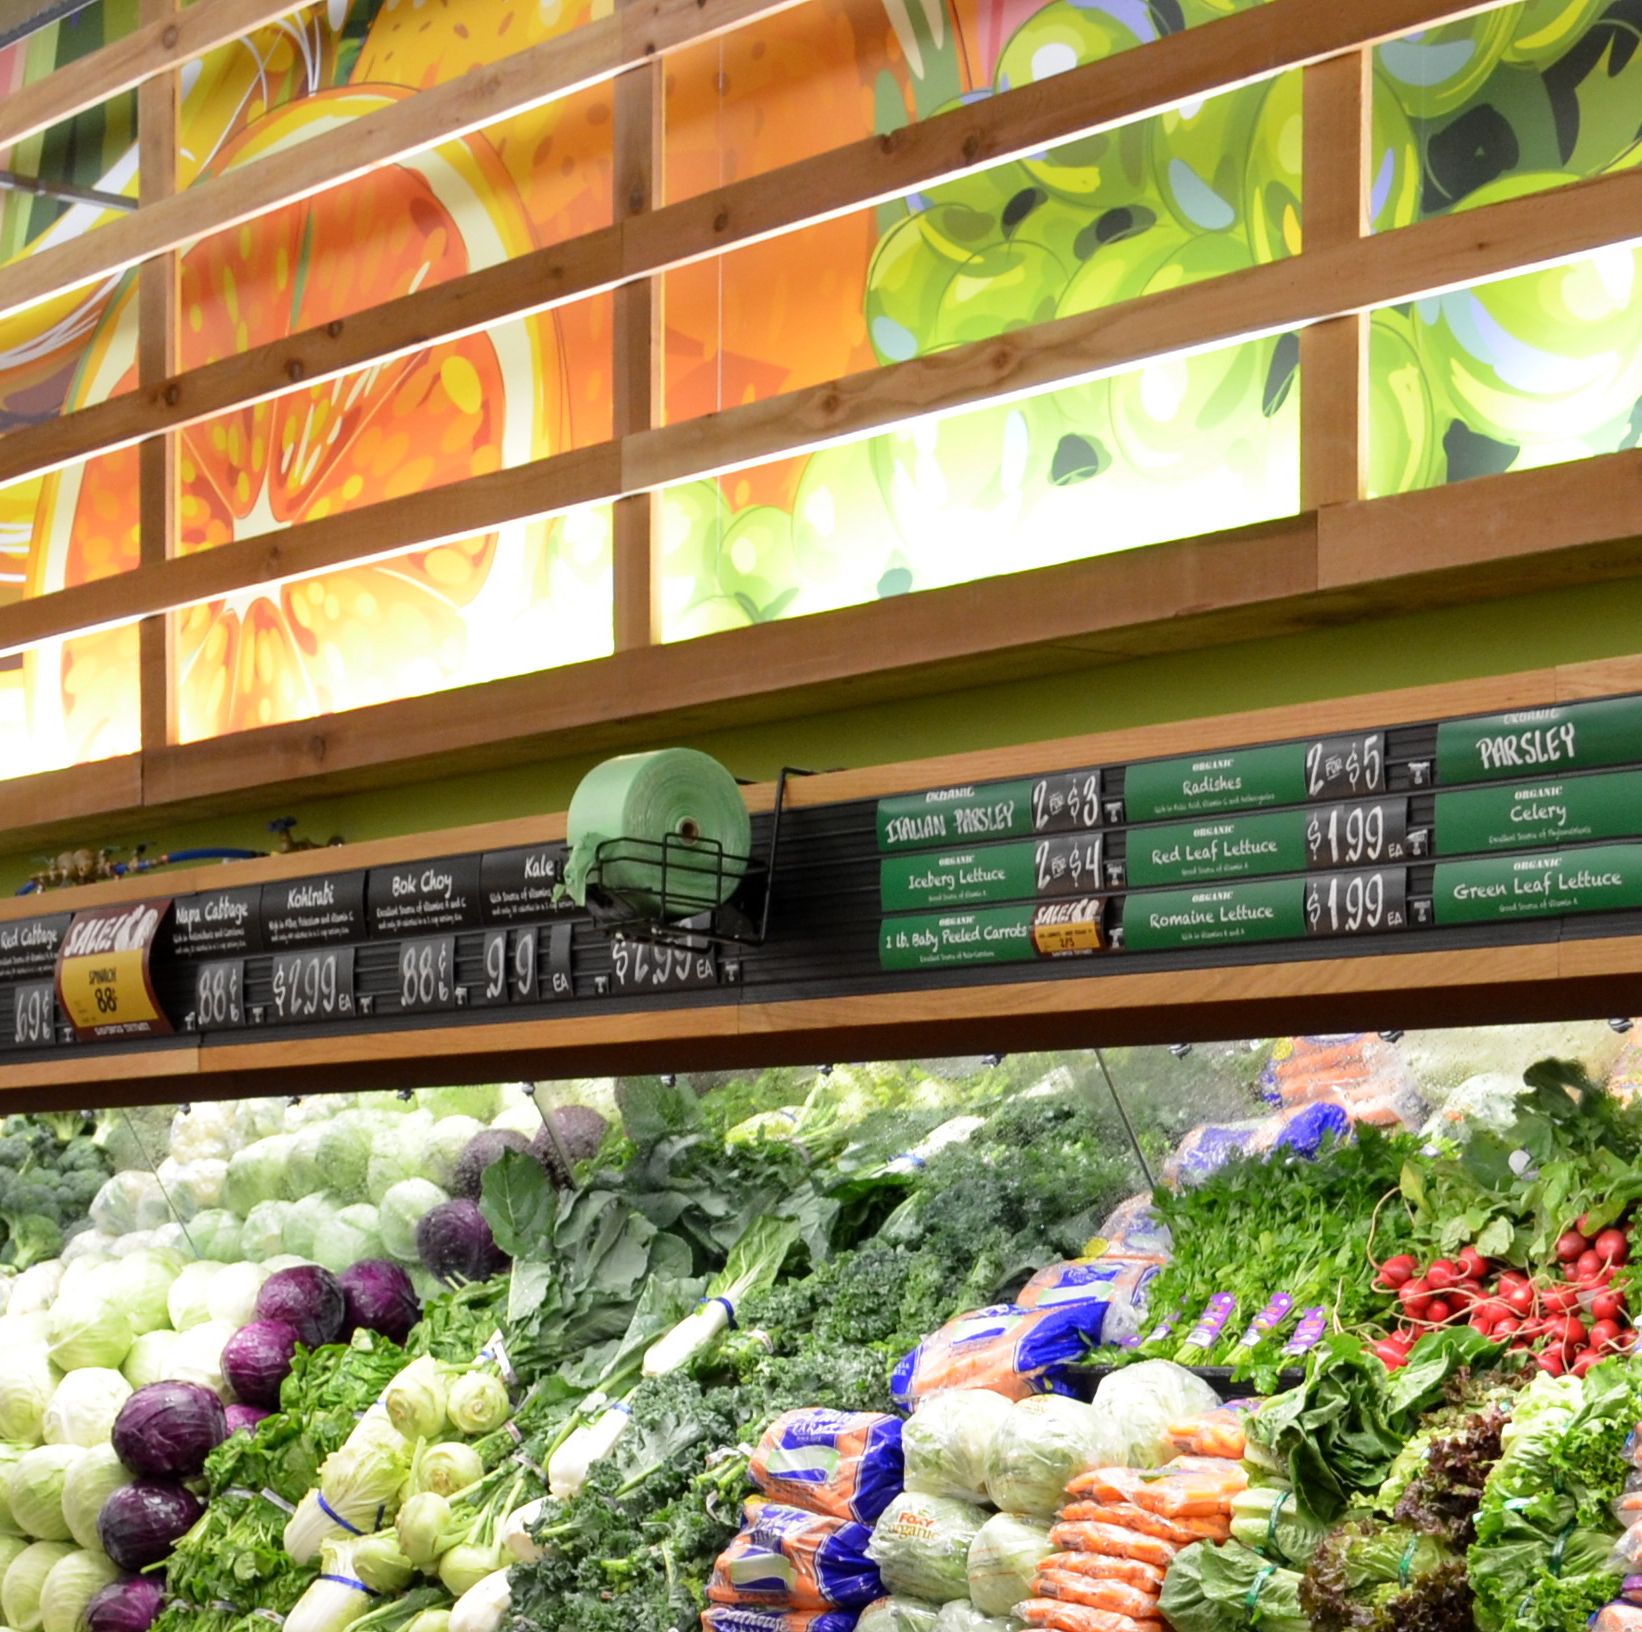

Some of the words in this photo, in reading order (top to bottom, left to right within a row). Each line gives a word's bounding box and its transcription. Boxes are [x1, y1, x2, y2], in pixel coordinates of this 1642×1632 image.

[1476, 722, 1576, 770] PARSLEY
[1193, 759, 1234, 771] ORGANIC
[1307, 743, 1323, 796] 2
[1183, 775, 1241, 796] Radishes
[1514, 786, 1563, 800] ORGANIC
[1034, 780, 1049, 829] 2
[1510, 802, 1567, 827] Celery
[885, 814, 947, 843] ITALIAN
[954, 800, 1014, 834] PARSLEY
[1193, 825, 1234, 837] ORGANIC
[1152, 848, 1180, 864] Red
[1186, 840, 1217, 861] Leaf
[1224, 840, 1277, 858] Lettuce
[1389, 843, 1403, 858] EA
[524, 854, 554, 879] Kale
[1036, 841, 1050, 889] 2
[1513, 858, 1562, 872] ORGANIC
[392, 875, 417, 897] Bok
[421, 869, 452, 899] Choy
[909, 871, 955, 890] Iceberg
[960, 867, 1006, 884] Lettuce
[1453, 881, 1506, 901] Green
[1514, 874, 1551, 896] Leaf
[1558, 870, 1622, 891] Lettuce
[287, 880, 335, 909] Kohlrabi
[1192, 891, 1233, 902] ORGANIC
[176, 907, 201, 937] Napa
[205, 896, 248, 925] Cabbage
[1150, 909, 1214, 928] Romaine
[1220, 904, 1274, 922] Lettuce
[1388, 911, 1402, 925] EA
[886, 936, 891, 948] 1
[912, 929, 938, 952] Baby
[942, 924, 980, 944] Peeled
[984, 922, 1028, 939] Carrots
[553, 973, 569, 992] EA
[888, 1522, 939, 1541] organic
[898, 1512, 934, 1528] FOXY
